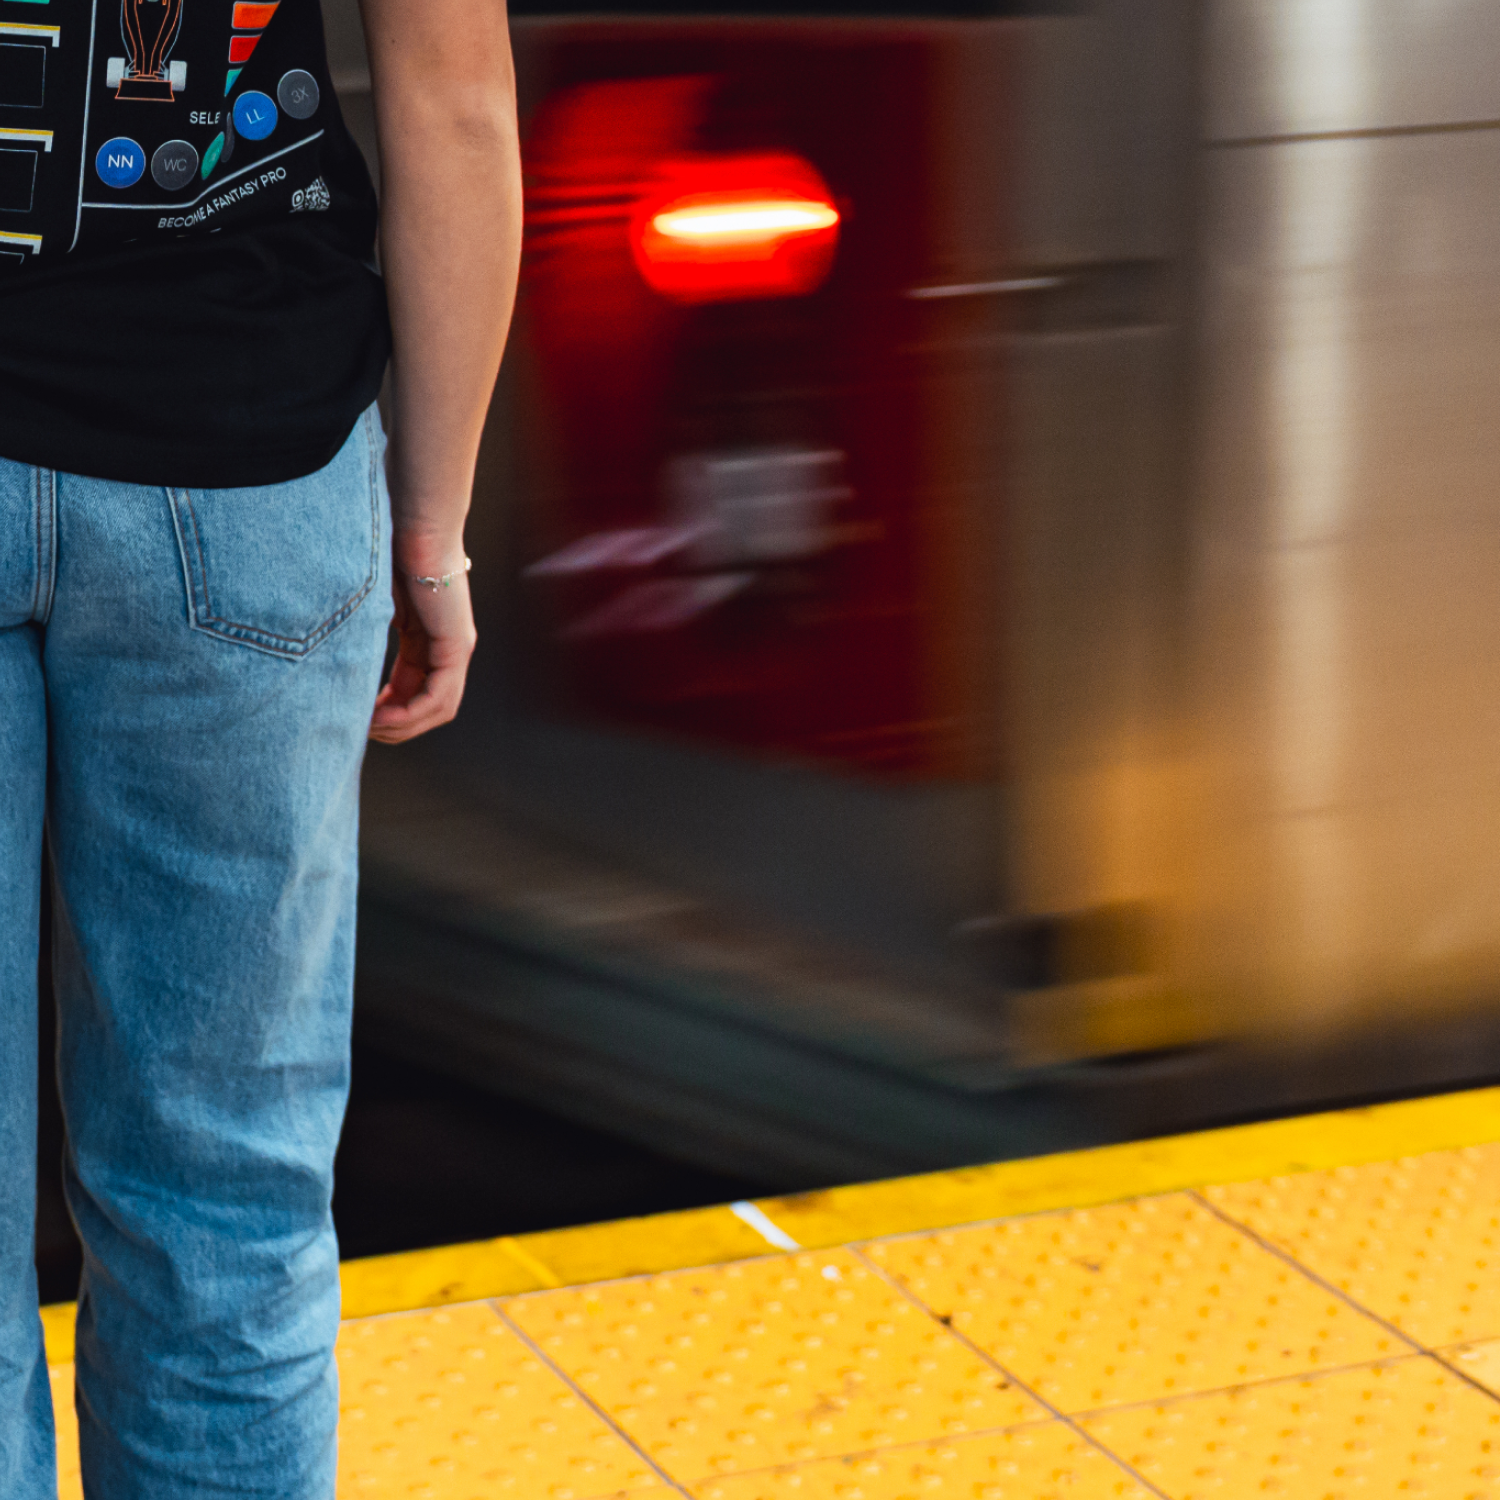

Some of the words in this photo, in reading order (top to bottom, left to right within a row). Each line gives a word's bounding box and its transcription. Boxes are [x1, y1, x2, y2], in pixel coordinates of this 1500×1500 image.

[291, 86, 309, 104] 3X
[245, 108, 265, 125] LL
[107, 154, 134, 169] NN
[163, 158, 187, 172] WC
[212, 178, 260, 211] FANTASY
[260, 166, 287, 188] PRO
